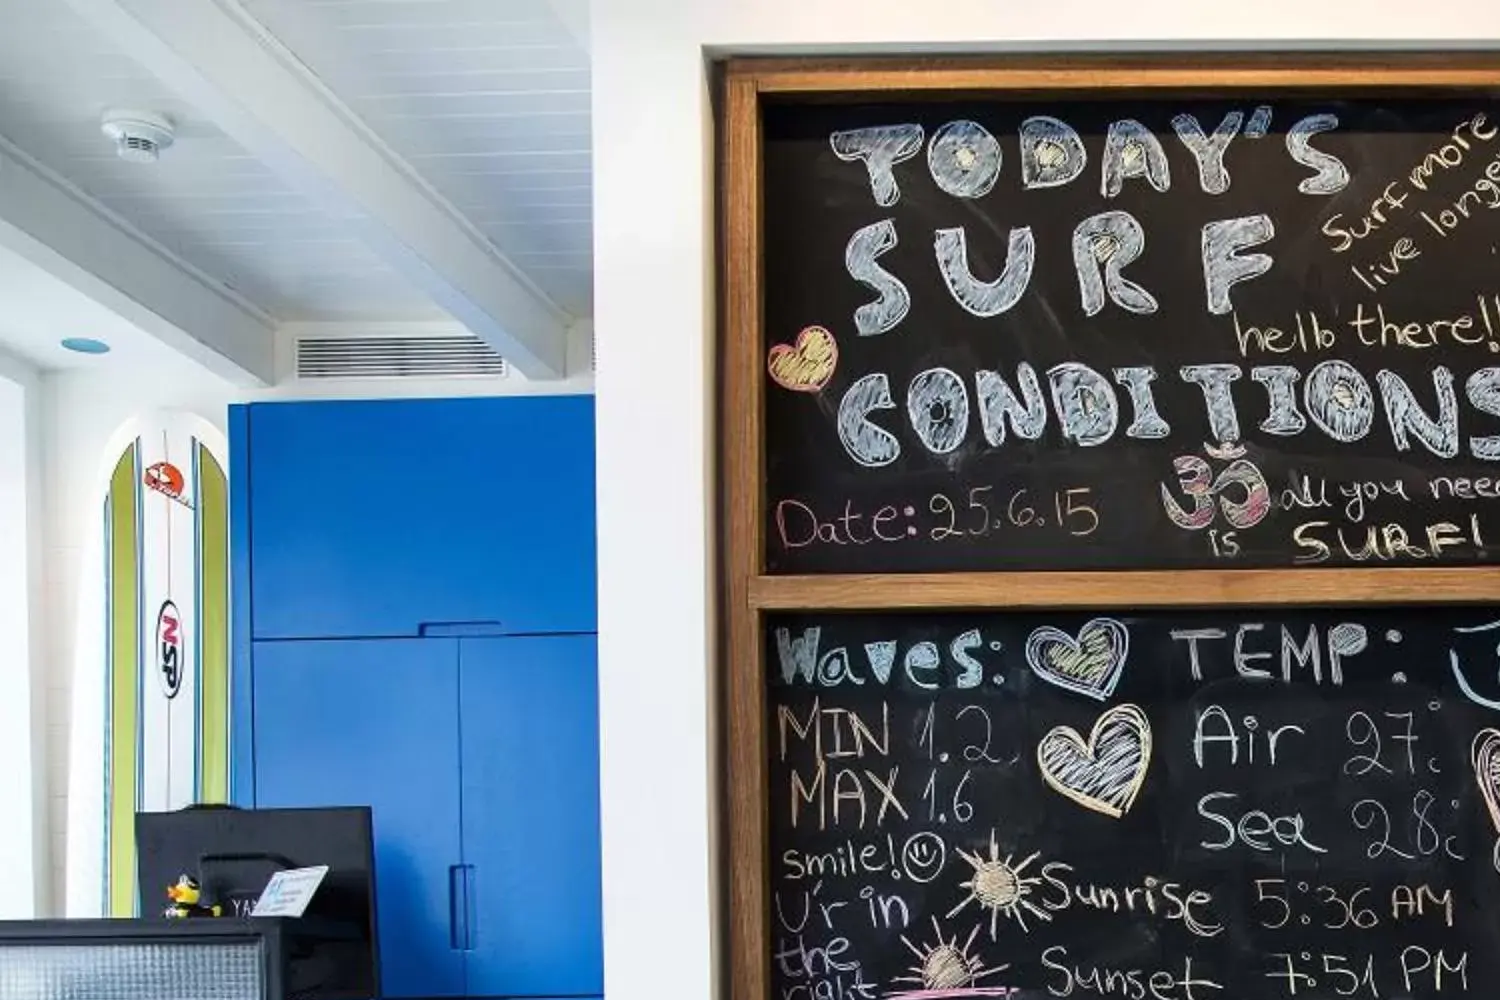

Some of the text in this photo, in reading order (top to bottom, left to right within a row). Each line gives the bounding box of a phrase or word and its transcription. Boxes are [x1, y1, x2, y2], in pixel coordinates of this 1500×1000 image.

[830, 105, 1350, 205] TODAY'S
[1322, 112, 1498, 252] Surf more
[845, 210, 1275, 336] SURF
[1351, 237, 1421, 292] live
[1233, 310, 1335, 356] hello
[776, 499, 918, 549] Date:
[1281, 475, 1332, 509] all
[1342, 476, 1406, 520] you
[1206, 527, 1240, 558] is
[162, 615, 178, 688] NSP
[775, 625, 1006, 689] Waves:
[1170, 623, 1407, 685] TEMP:
[777, 703, 889, 763] MIN
[1194, 705, 1303, 768] Air
[791, 760, 908, 830] MAX
[1200, 792, 1328, 855] Sea
[783, 838, 902, 880] smile!
[860, 885, 910, 930] in
[1040, 863, 1454, 937] Sunrise 5:36 AM
[775, 935, 861, 978] the
[1265, 953, 1376, 997] 7:51
[1401, 947, 1469, 993] PM
